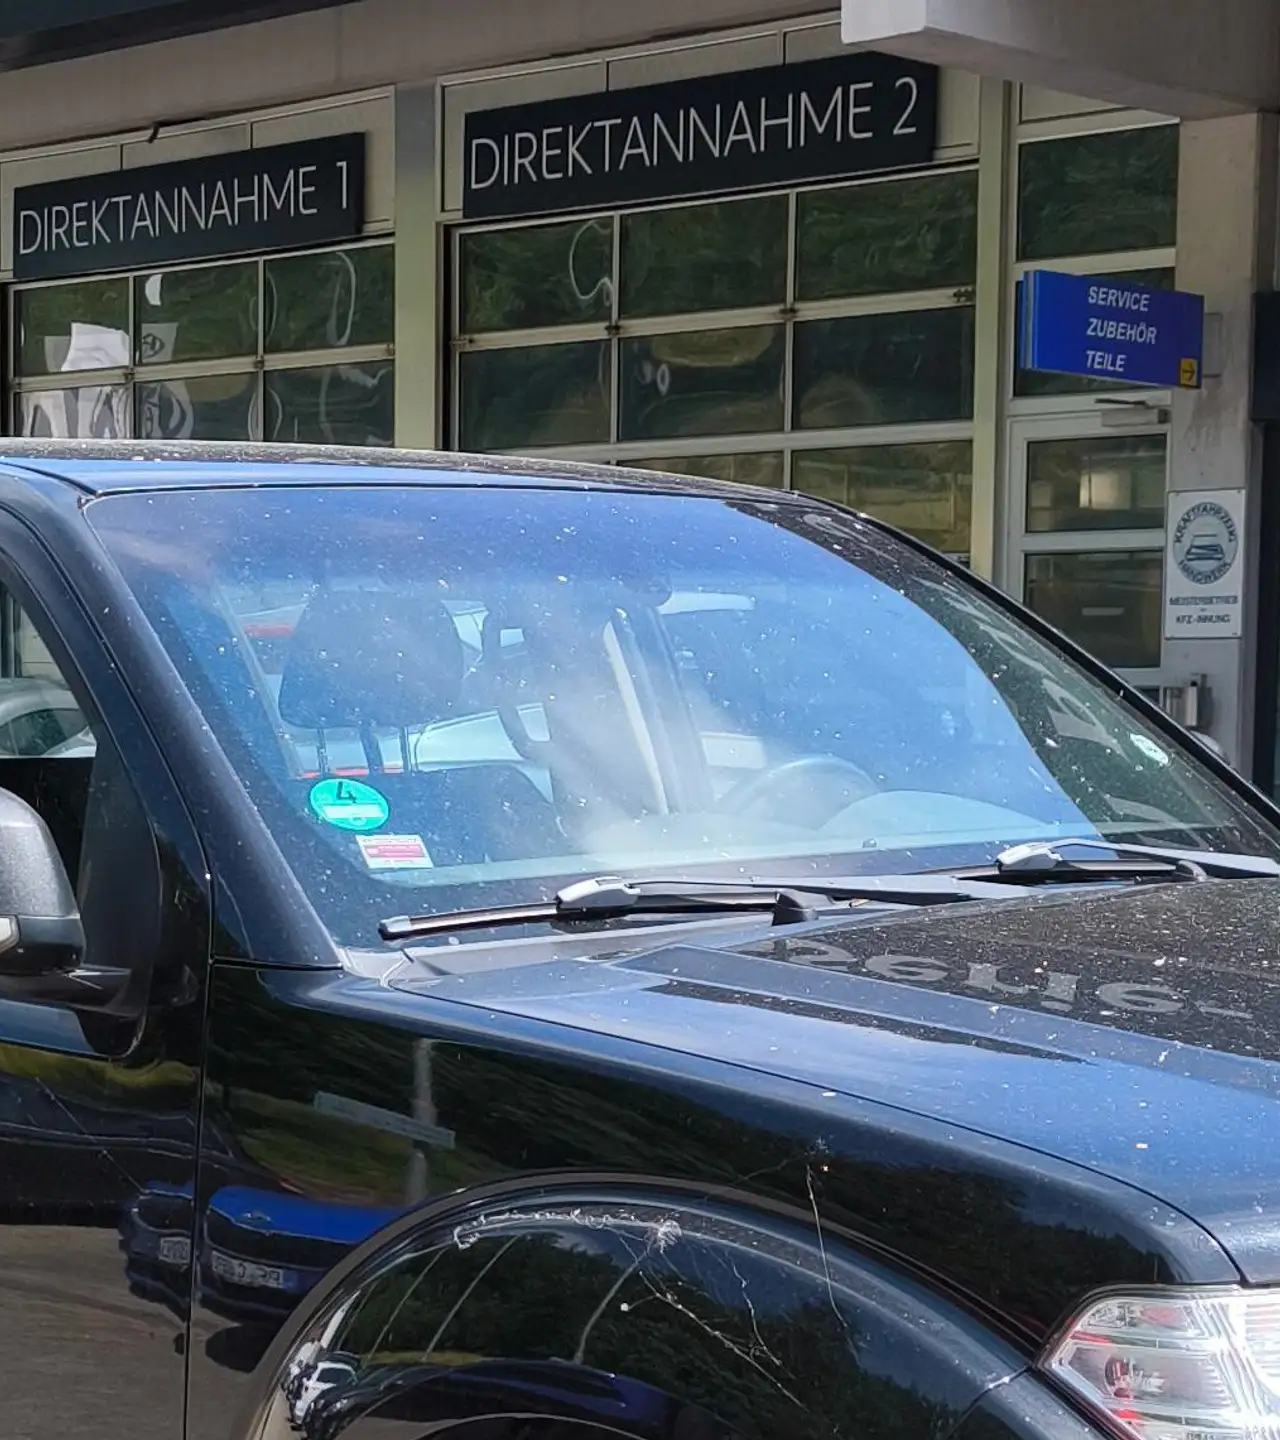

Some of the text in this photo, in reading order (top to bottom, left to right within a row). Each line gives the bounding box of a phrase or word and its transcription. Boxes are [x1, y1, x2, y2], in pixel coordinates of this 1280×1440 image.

[470, 76, 918, 190] DIREKTANNAHME 2
[19, 161, 348, 255] DIREKTANNAHME 1
[1088, 286, 1151, 312] SERVICE
[1086, 317, 1157, 345] ZUBEHÖR
[1086, 350, 1127, 372] TEILE
